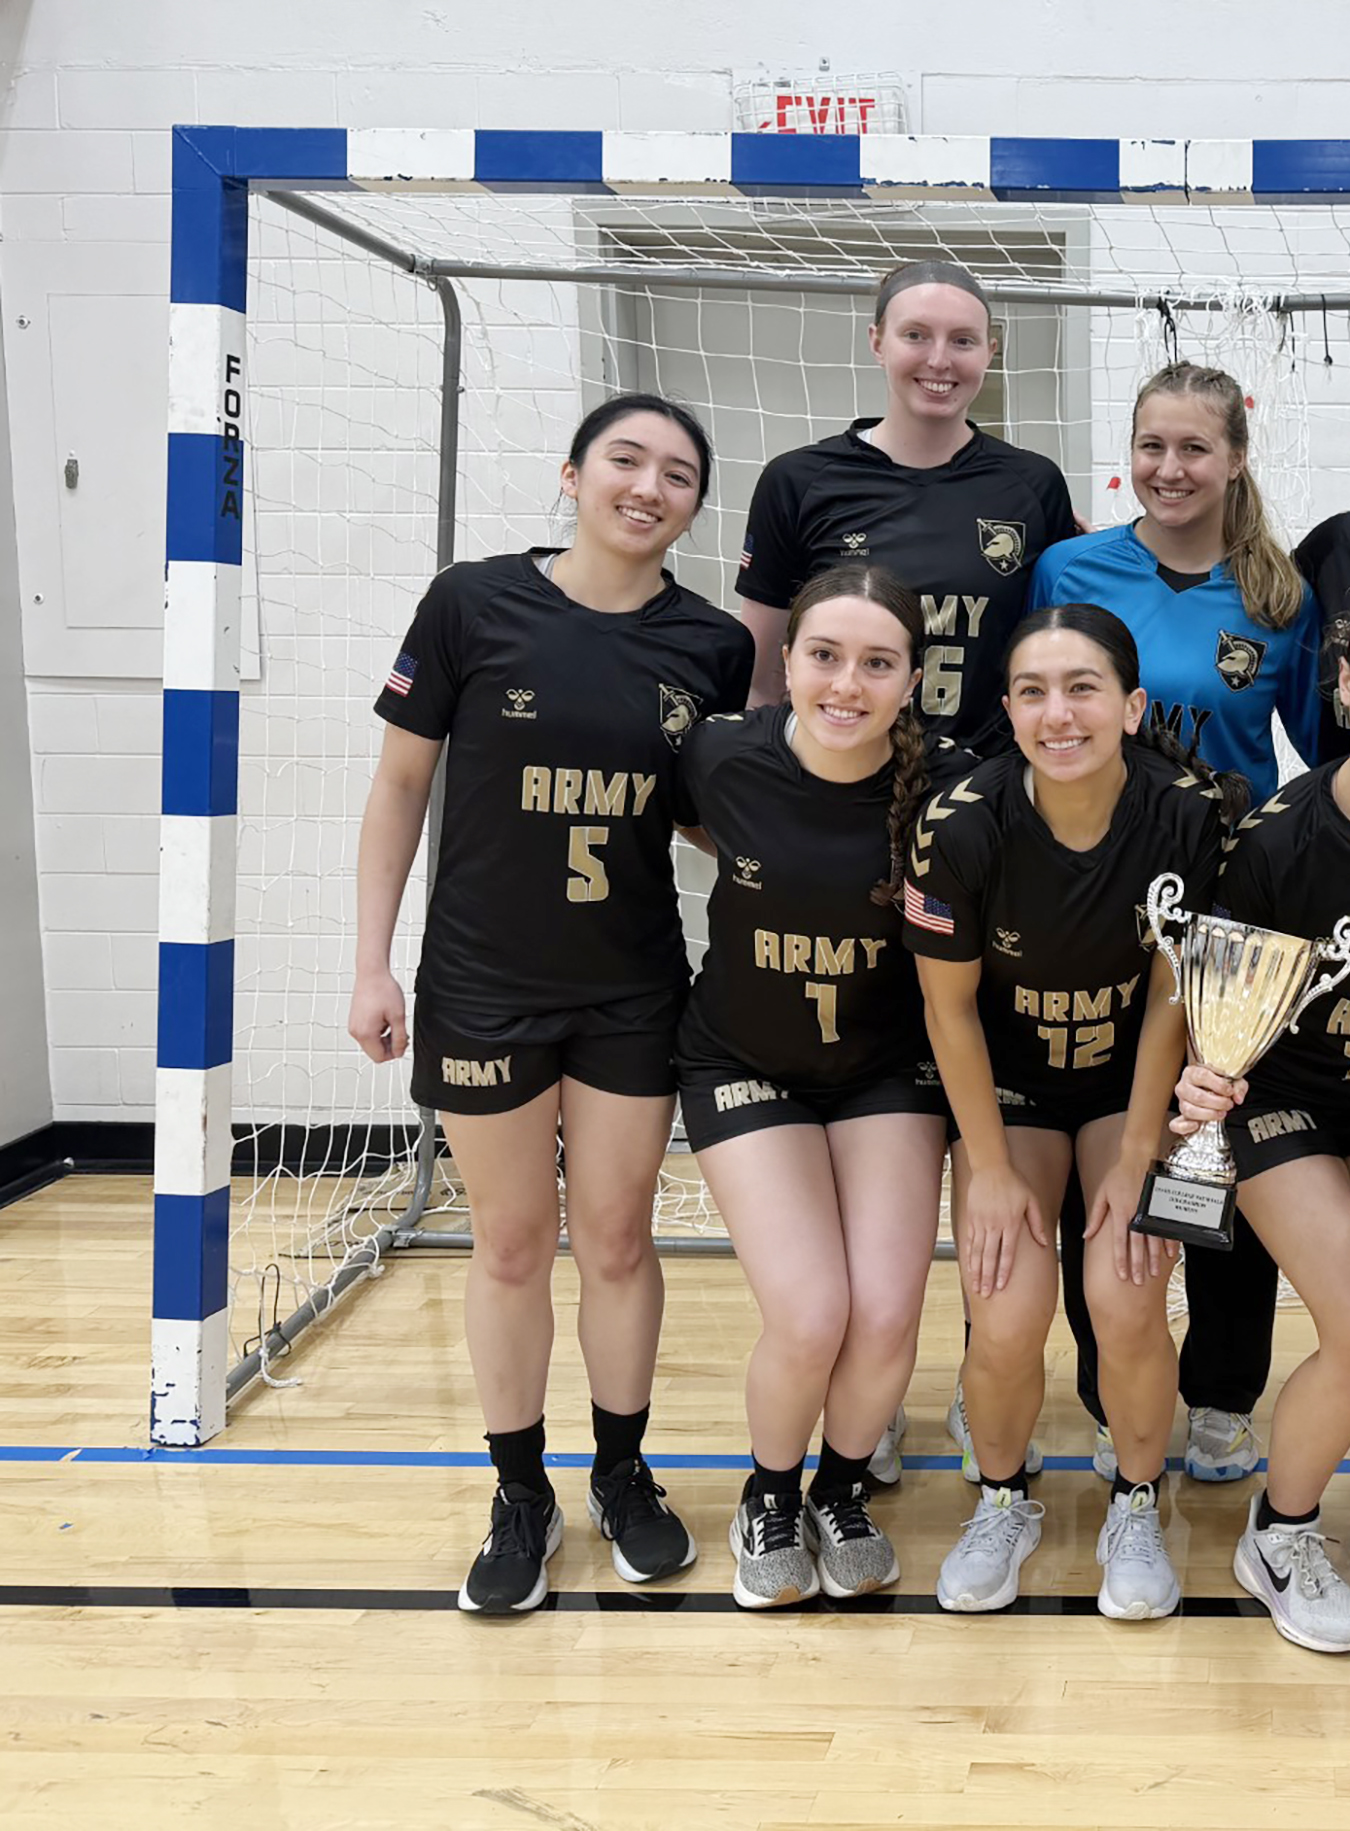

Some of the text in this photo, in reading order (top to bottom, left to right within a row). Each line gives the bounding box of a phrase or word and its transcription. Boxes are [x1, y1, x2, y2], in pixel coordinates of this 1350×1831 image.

[221, 355, 241, 519] FORZA
[919, 595, 990, 637] MY
[921, 645, 965, 716] 6
[501, 707, 538, 720] hummel
[1149, 699, 1214, 747] MY
[521, 765, 656, 816] ARMY
[566, 825, 609, 902] 5
[754, 928, 887, 976] ARMY
[1014, 972, 1141, 1022] ARMY
[1037, 1021, 1115, 1070] 12
[441, 1055, 512, 1087] ARMY
[1247, 1109, 1316, 1144] ARMY
